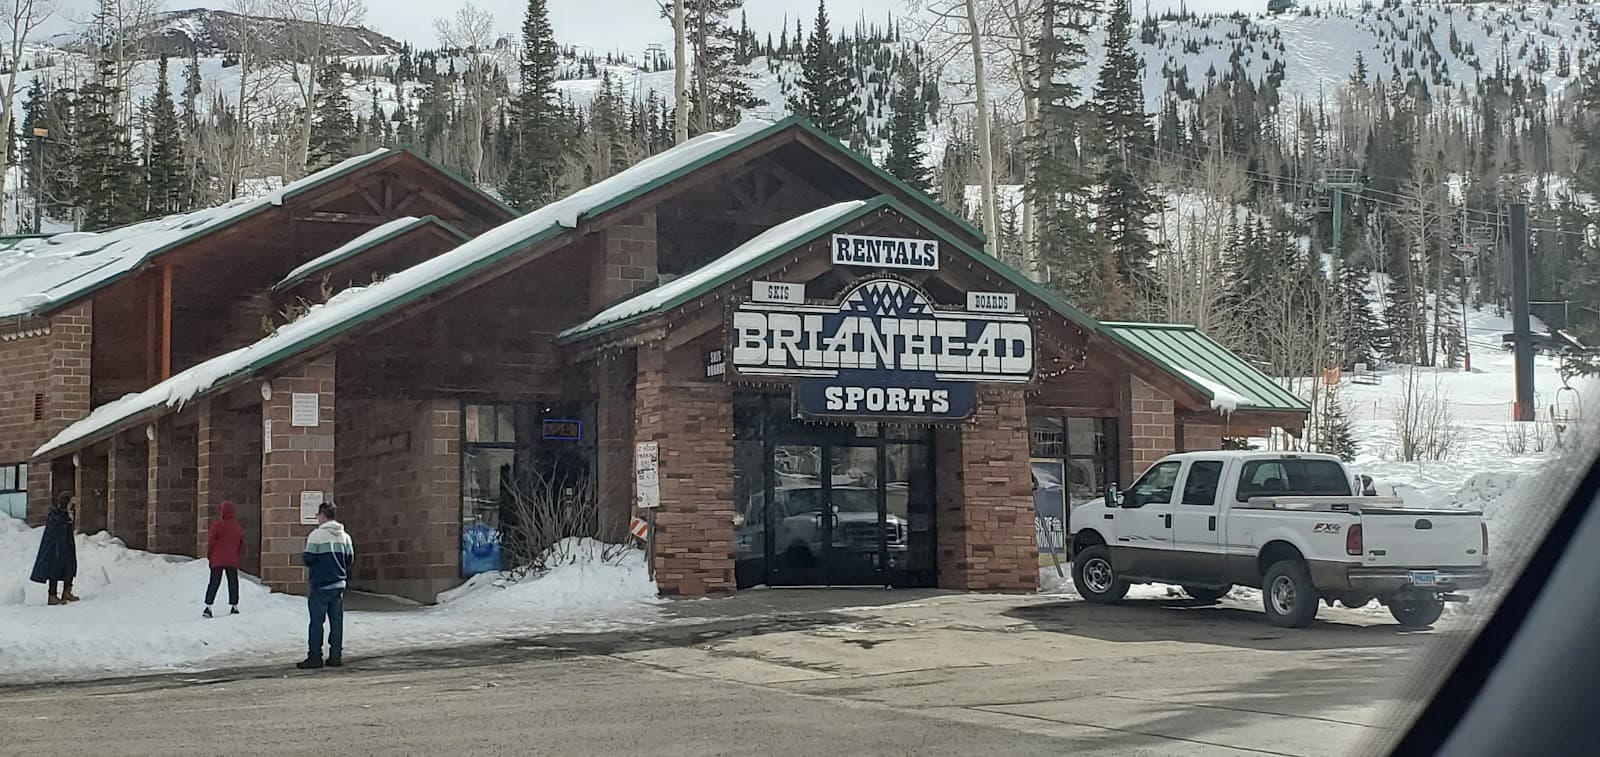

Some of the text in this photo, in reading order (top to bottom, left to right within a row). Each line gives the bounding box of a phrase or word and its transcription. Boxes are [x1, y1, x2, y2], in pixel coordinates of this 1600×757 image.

[836, 237, 935, 267] RENTALS
[767, 285, 790, 300] SKIS
[975, 294, 1009, 310] BOARDS
[825, 386, 950, 413] SPORTS
